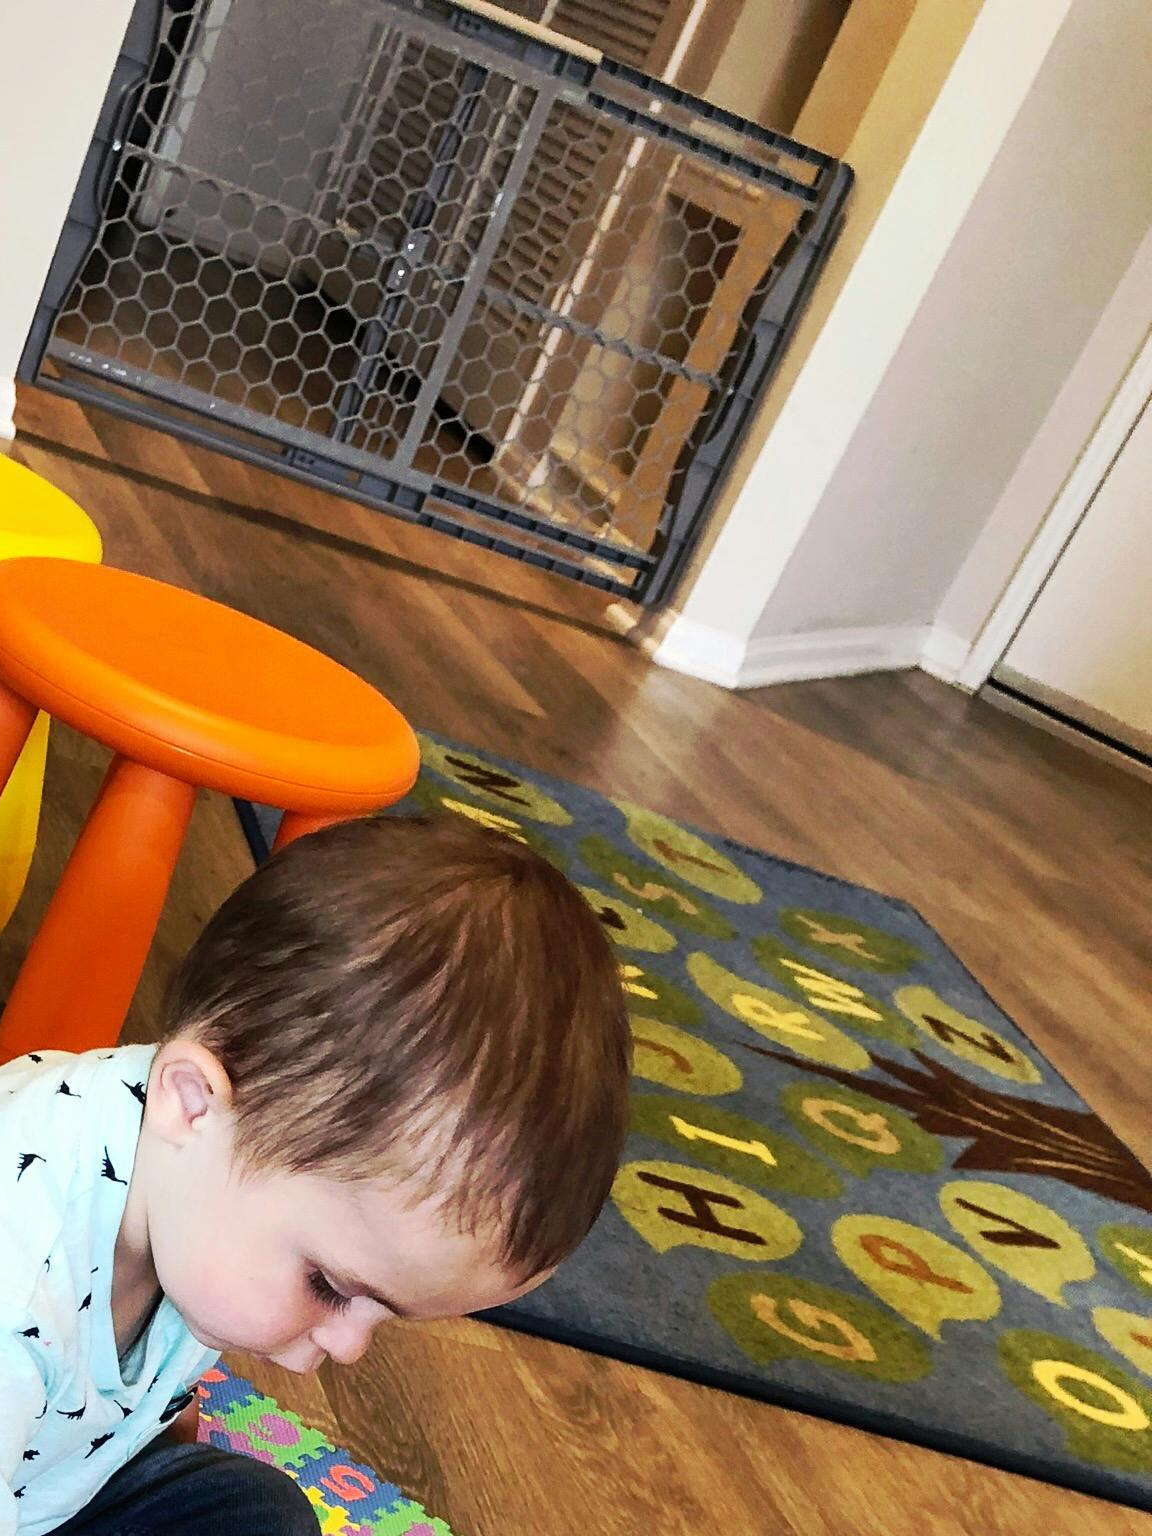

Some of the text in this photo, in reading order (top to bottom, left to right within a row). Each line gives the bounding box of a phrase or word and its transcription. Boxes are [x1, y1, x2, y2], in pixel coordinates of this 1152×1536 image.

[445, 756, 532, 807] N
[613, 873, 697, 915] S
[797, 914, 887, 961] X
[779, 957, 883, 1021] W
[731, 994, 827, 1040] R
[924, 1014, 1014, 1064] Z
[802, 1098, 900, 1152] Q
[638, 1169, 767, 1247] H
[955, 1197, 1061, 1249] V
[859, 1234, 973, 1293] P
[751, 1293, 876, 1361] G
[1032, 1359, 1147, 1430] O
[320, 1464, 374, 1500] 5
